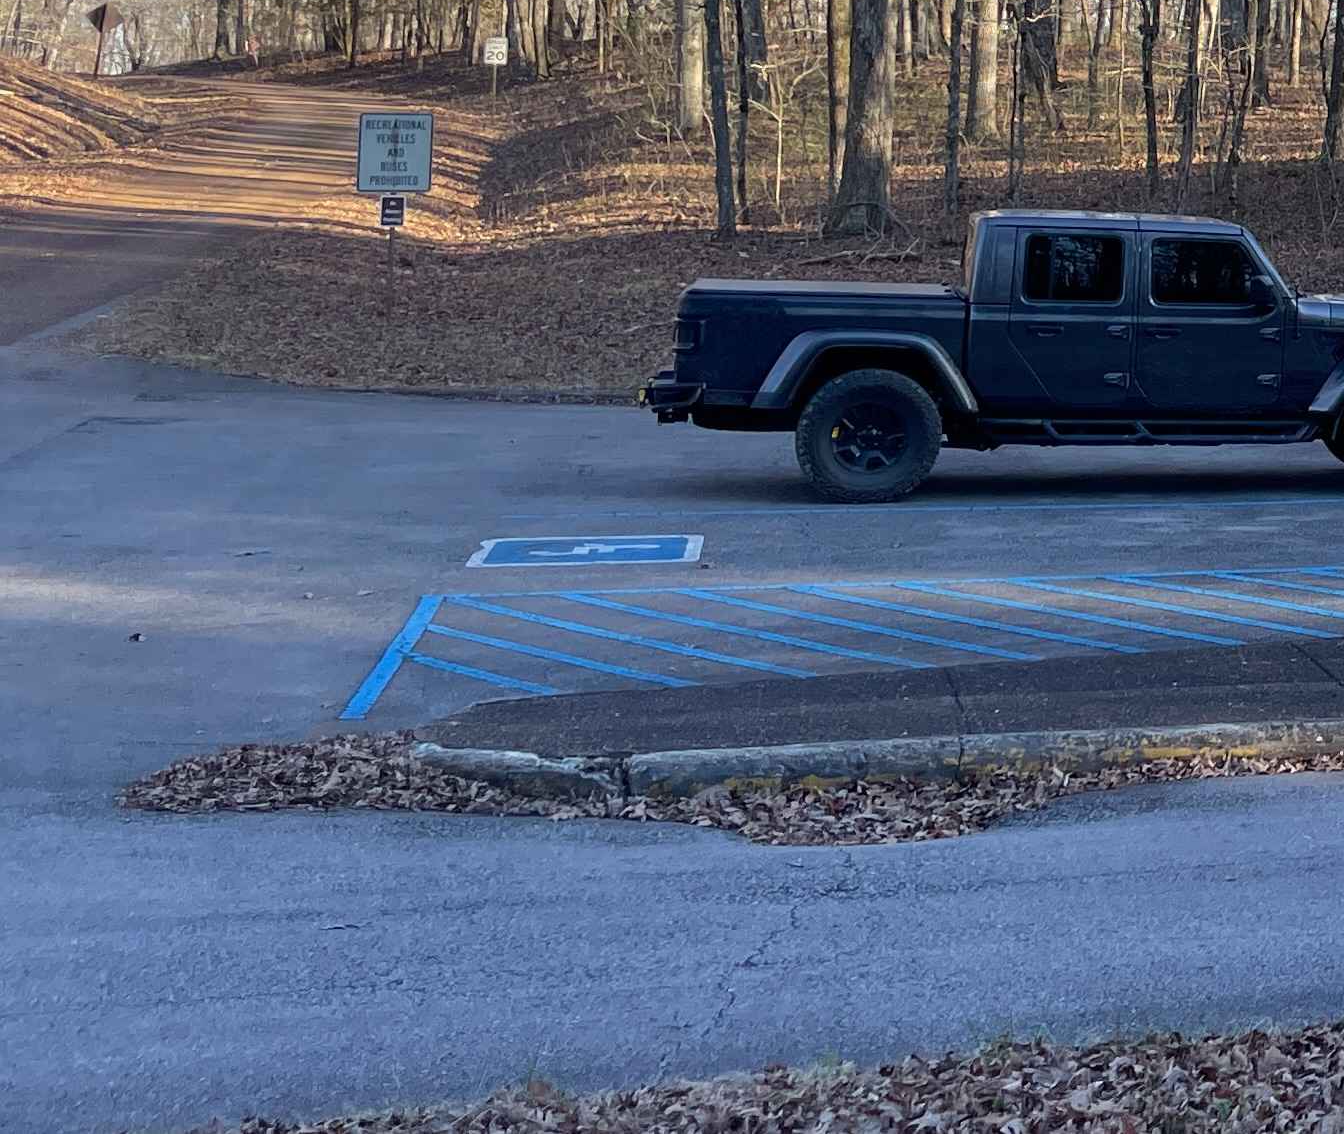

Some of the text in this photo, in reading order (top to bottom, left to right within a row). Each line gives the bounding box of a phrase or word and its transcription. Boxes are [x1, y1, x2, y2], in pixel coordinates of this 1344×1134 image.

[486, 50, 505, 61] 20
[365, 119, 427, 131] RECREATIONAL
[387, 147, 405, 158] AND
